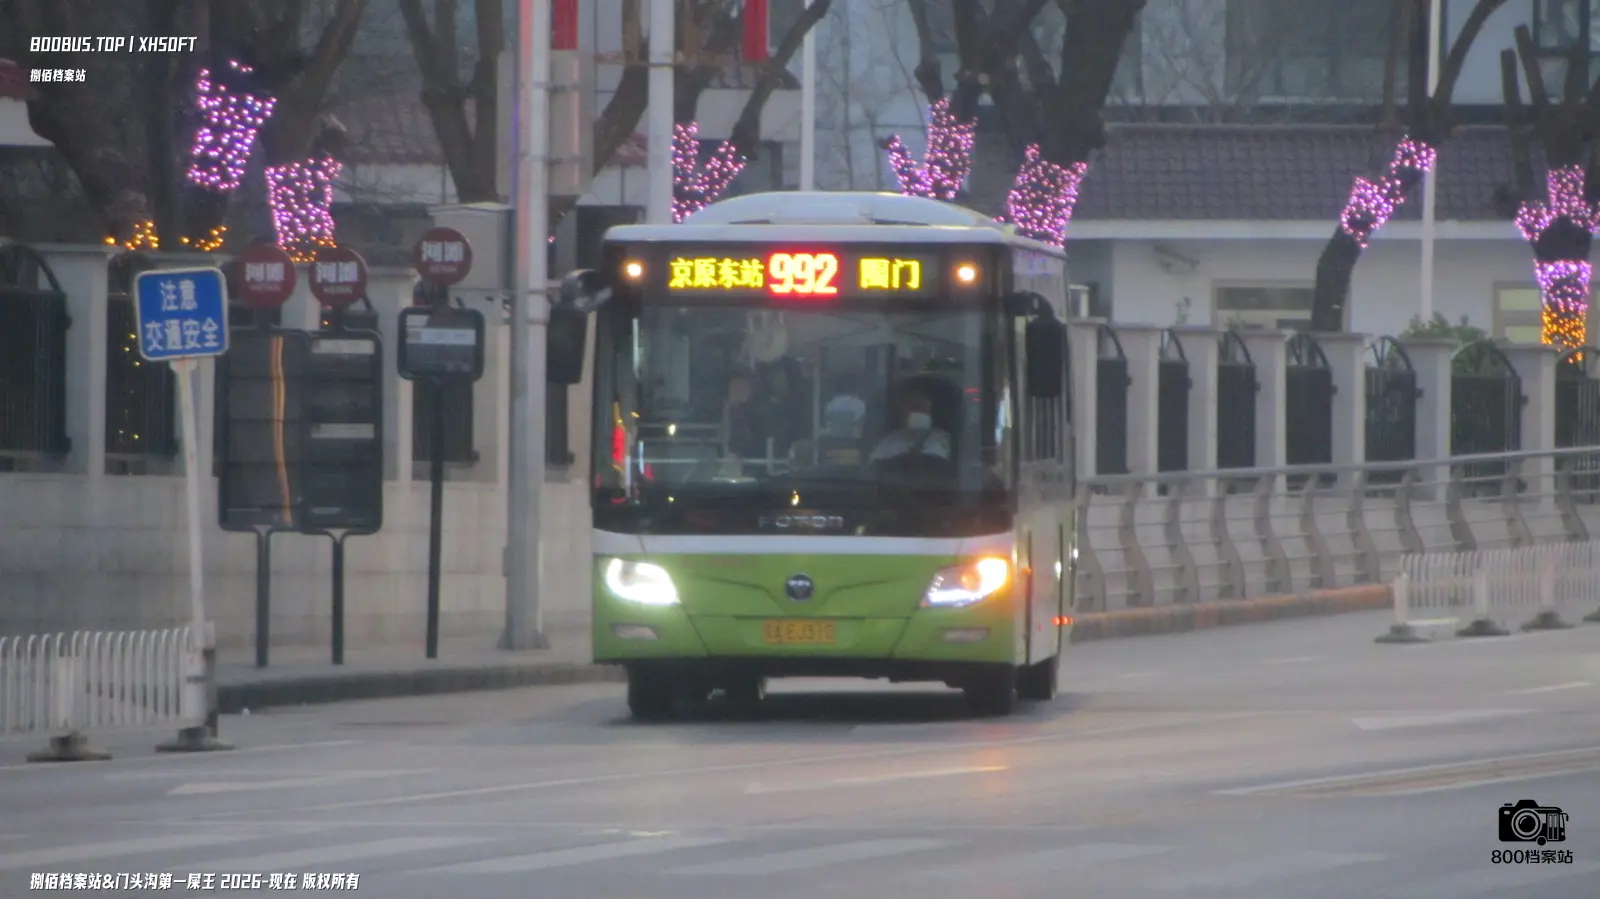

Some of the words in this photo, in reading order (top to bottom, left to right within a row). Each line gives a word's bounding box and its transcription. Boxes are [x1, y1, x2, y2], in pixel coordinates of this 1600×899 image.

[668, 257, 764, 288] 京原东站
[768, 252, 838, 295] 992
[160, 278, 198, 312] 注意
[145, 316, 220, 352] 交通安全
